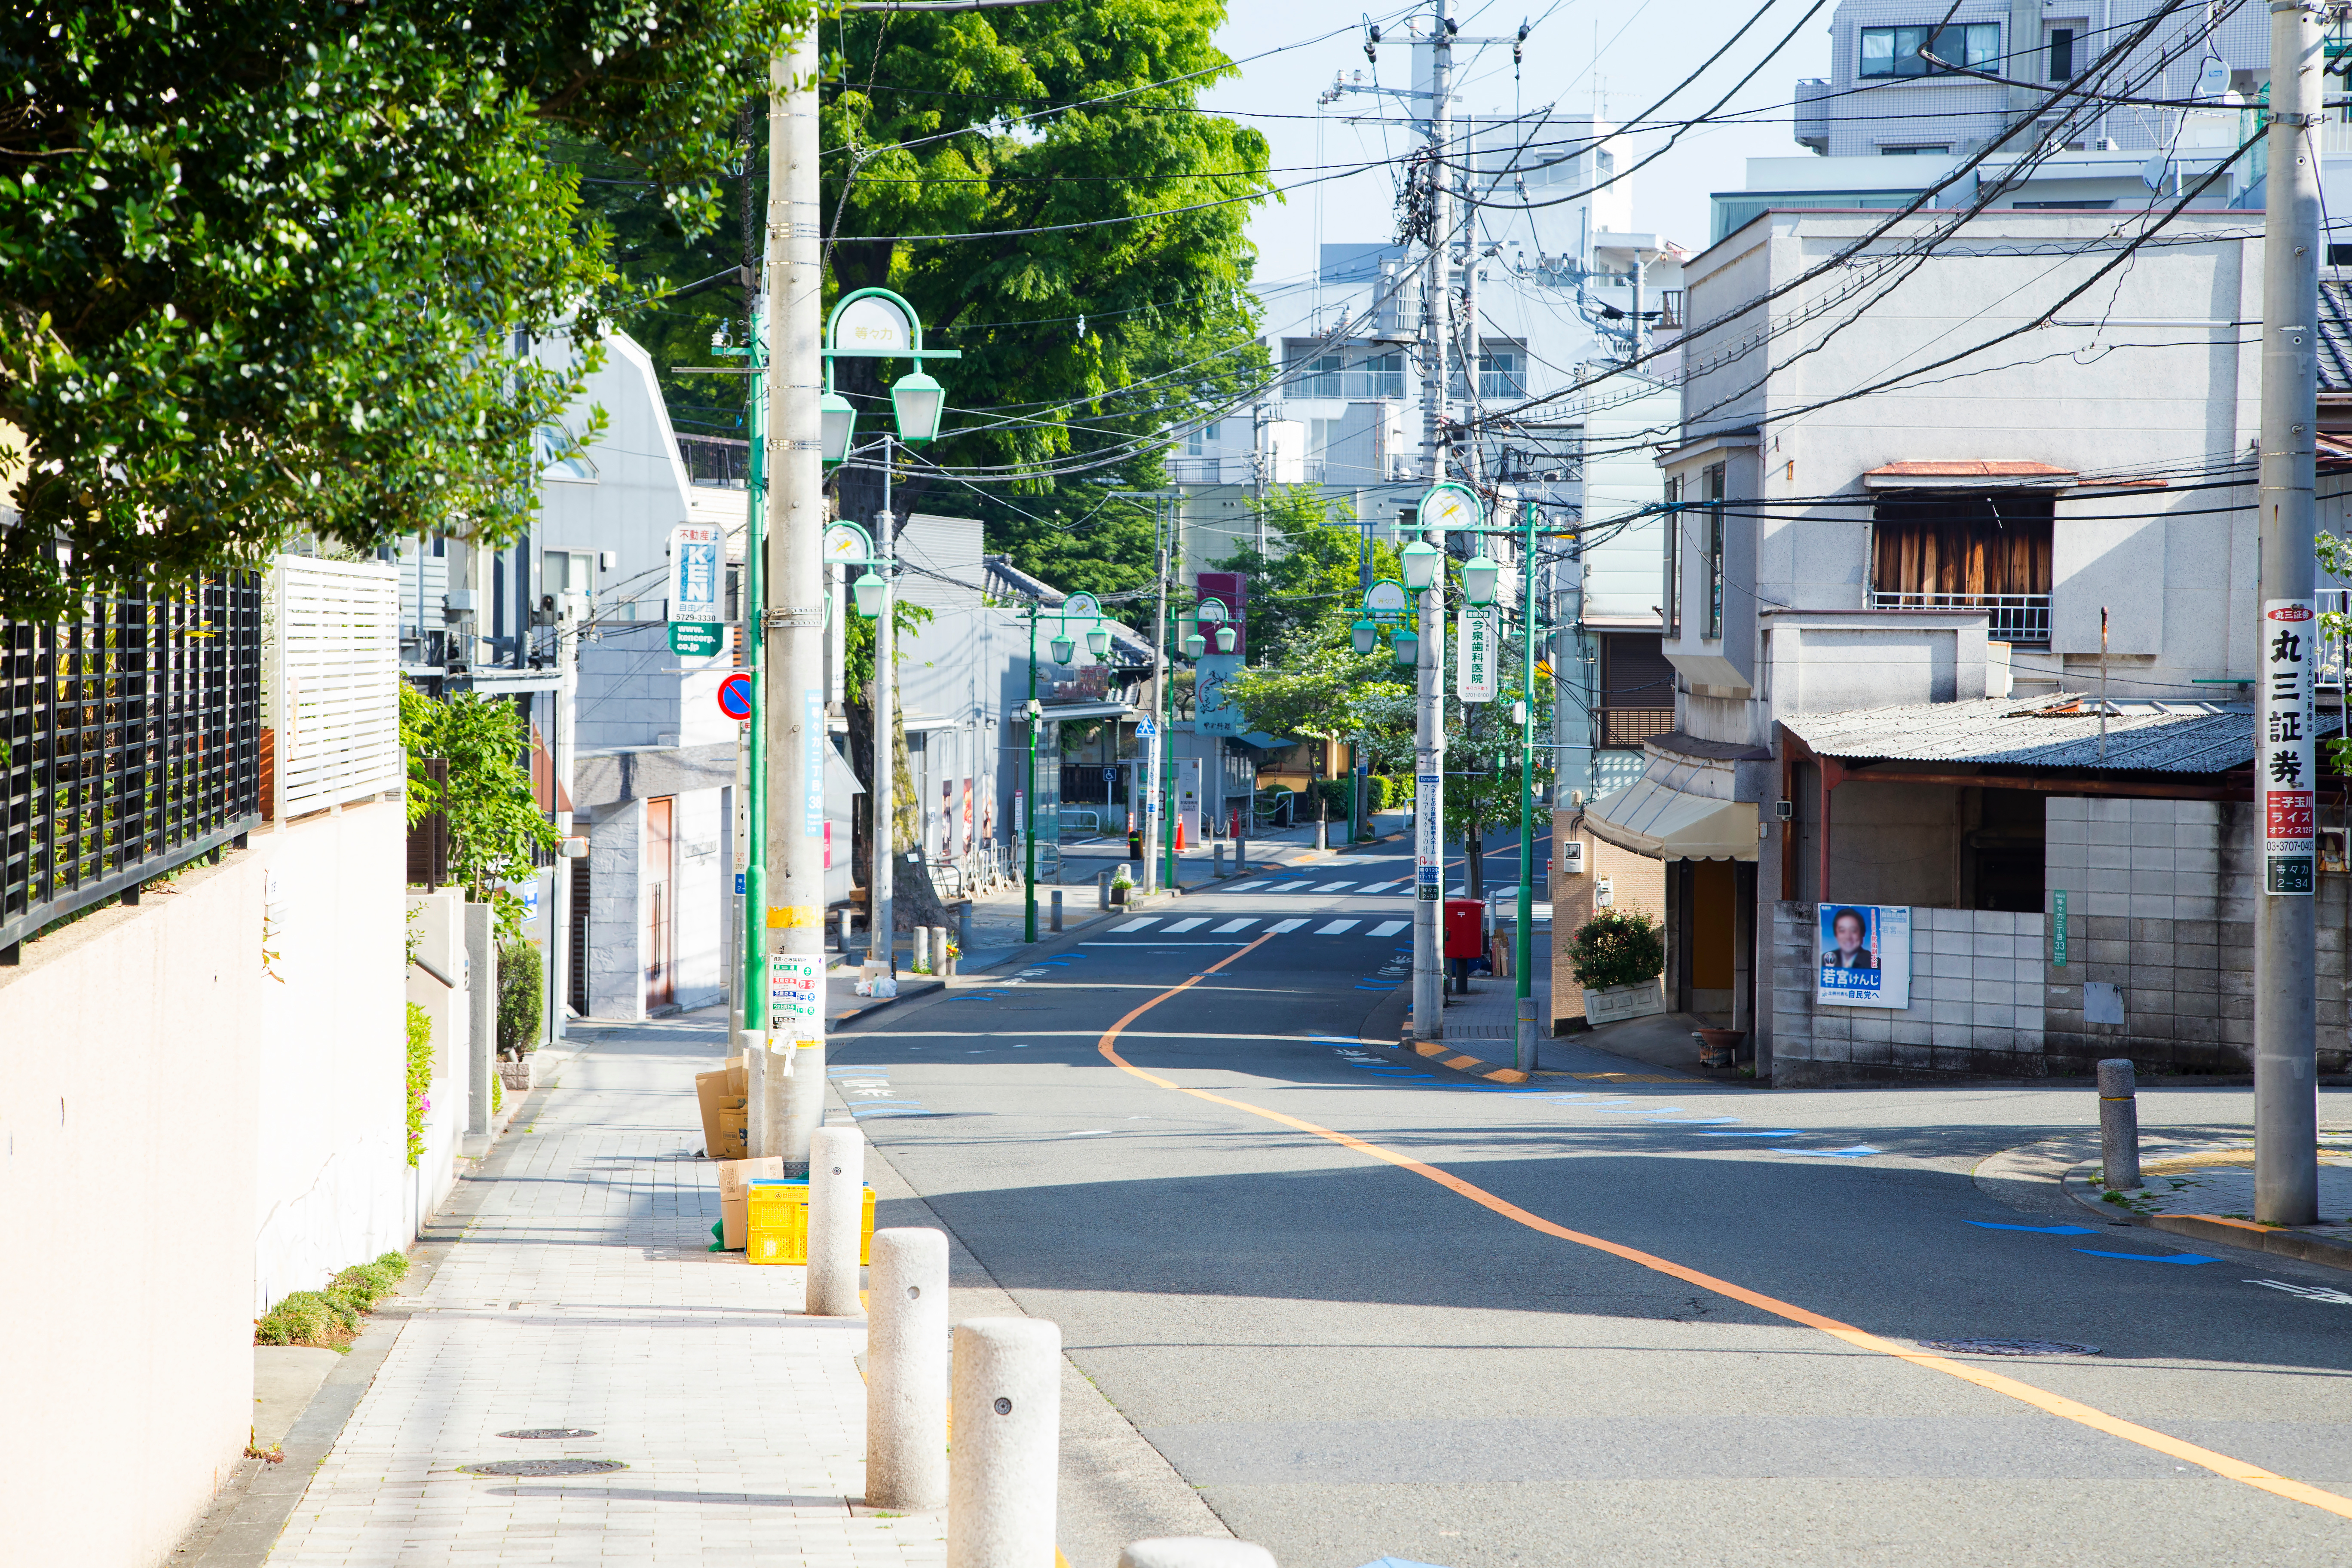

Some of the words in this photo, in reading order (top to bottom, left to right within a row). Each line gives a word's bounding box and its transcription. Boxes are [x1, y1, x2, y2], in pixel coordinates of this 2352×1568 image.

[855, 327, 892, 340] 等々力
[680, 530, 719, 540] 不動産は
[687, 545, 708, 600] KEN
[2275, 610, 2309, 619] 丸三証券
[677, 633, 716, 643] kencorp.
[677, 642, 699, 652] co.jp
[1472, 620, 1484, 683] 今泉歯科医院
[2269, 629, 2303, 783] 丸三証券
[812, 707, 821, 791] 等々力二丁目
[808, 796, 821, 809] 38
[2269, 796, 2312, 808] 二子玉川
[2272, 811, 2310, 823] ライズ
[2267, 841, 2313, 851] 03-3707-0403
[2276, 865, 2308, 874] 等々力
[2277, 879, 2308, 888] 2-34
[2055, 941, 2064, 950] 33
[1822, 968, 1879, 986] 若宮けんじ
